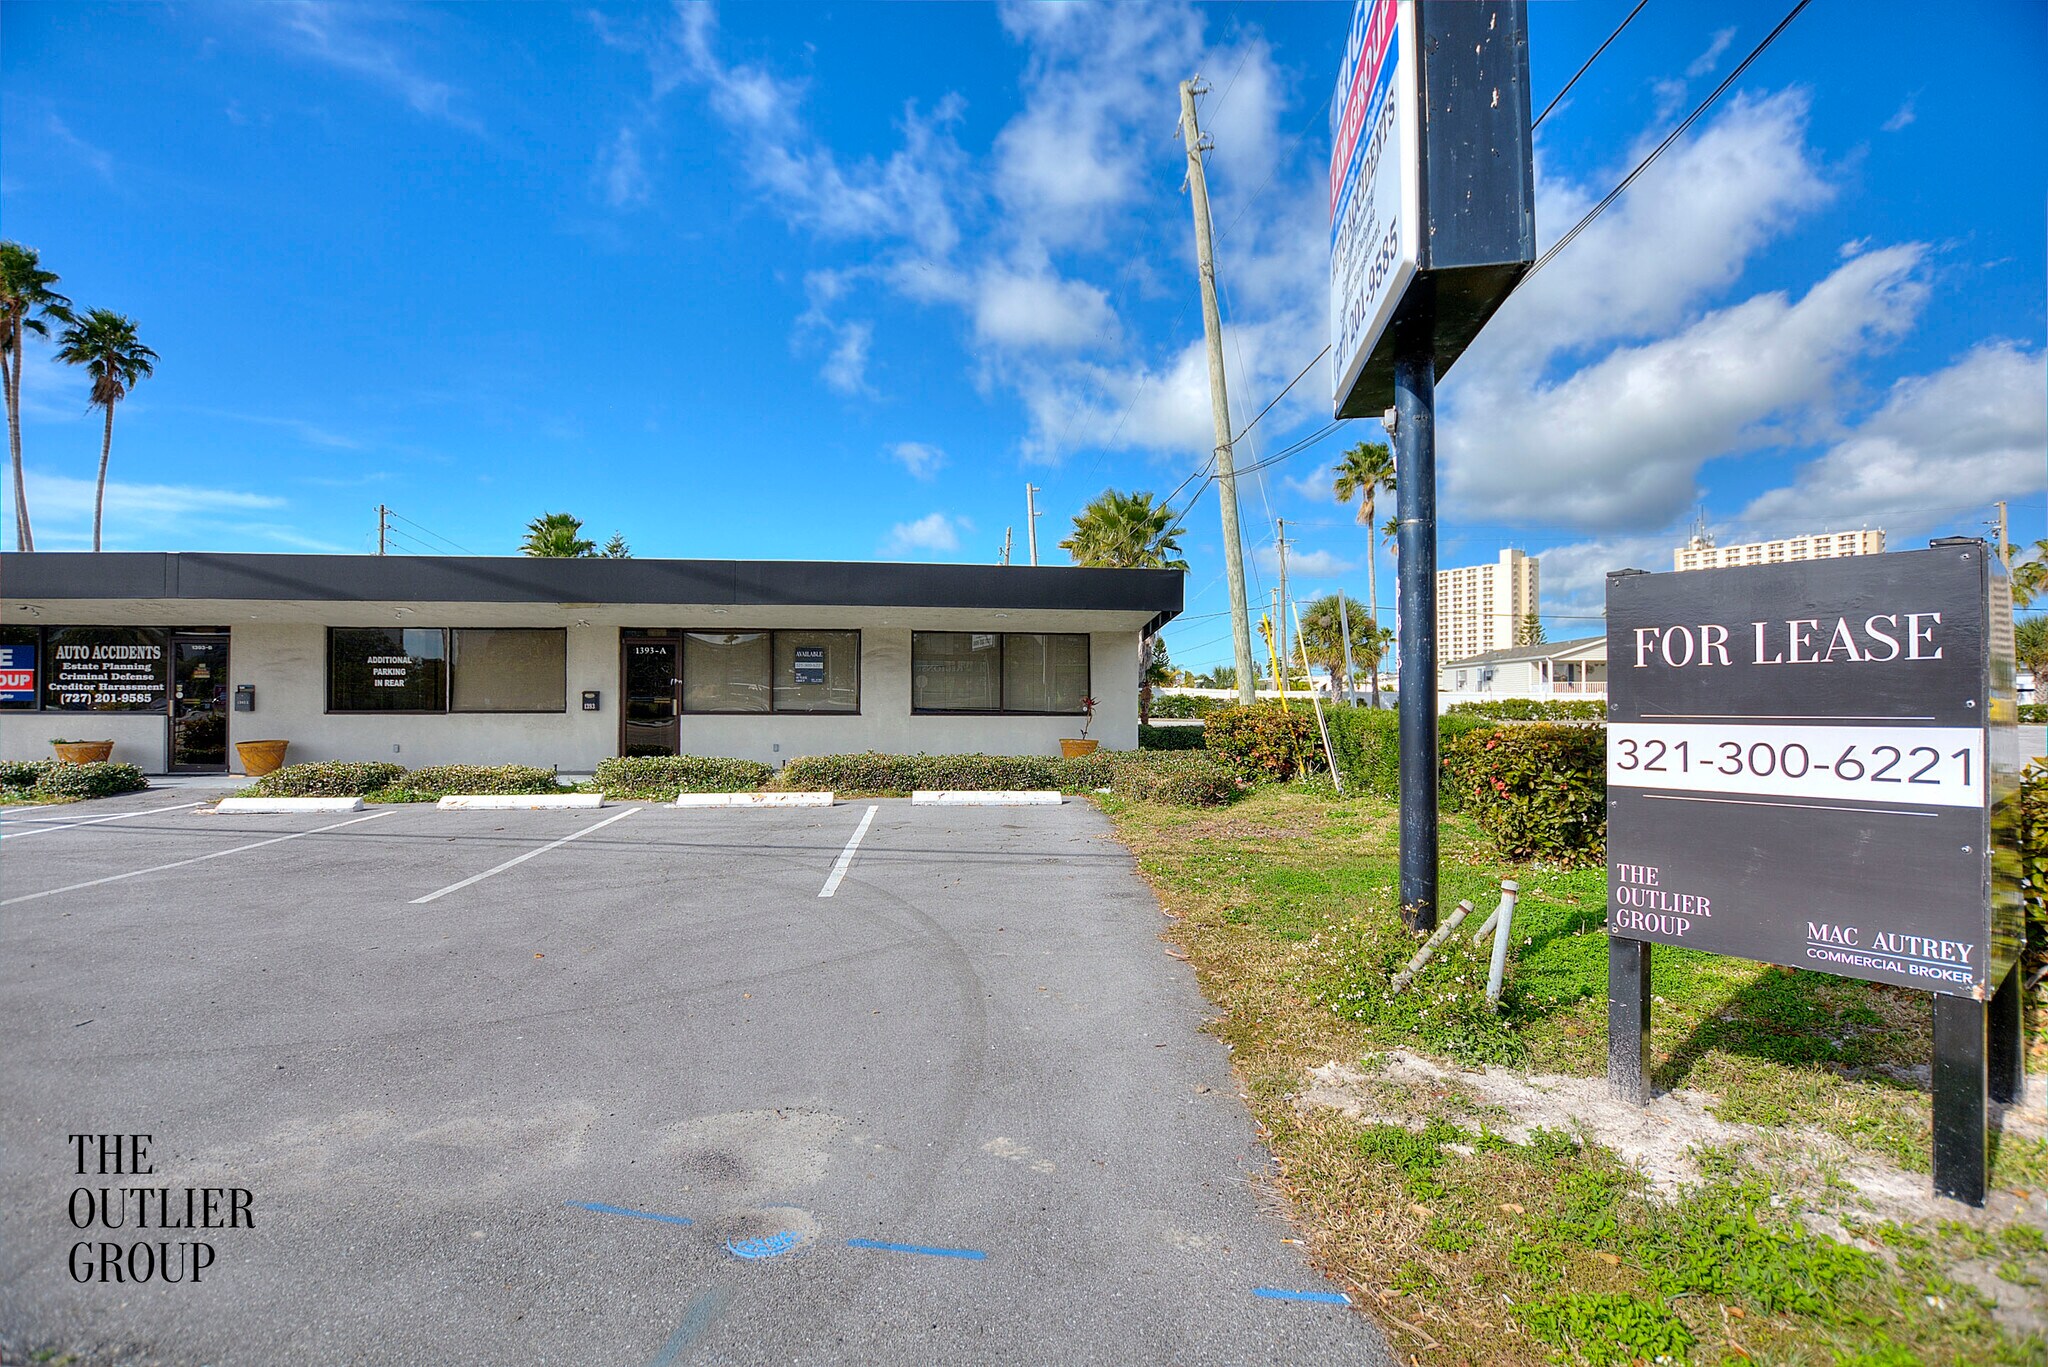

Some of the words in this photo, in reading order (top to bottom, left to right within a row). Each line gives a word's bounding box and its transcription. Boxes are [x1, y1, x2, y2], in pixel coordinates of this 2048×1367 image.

[1331, 121, 1349, 203] LAW
[1332, 224, 1347, 287] AUTO
[1347, 86, 1395, 241] ACCIDENTS
[1349, 214, 1397, 344] 201-9585
[56, 645, 89, 659] AUTO
[92, 645, 161, 659] ACCIDENTS
[1633, 624, 1732, 669] FOR
[1752, 612, 1943, 664] LEASE
[63, 663, 99, 671] Estate
[102, 663, 151, 672] Planning
[367, 657, 412, 665] ADDITIONAL
[373, 668, 406, 676] PARKING
[49, 683, 96, 691] Creditor
[99, 683, 164, 691] Harassment
[375, 679, 383, 687] IN
[385, 679, 405, 687] REAR
[61, 693, 91, 705] (727)
[95, 693, 151, 703] 201-9585
[1616, 738, 1972, 786] 321-300-6221
[1616, 863, 1660, 886] THE
[1616, 885, 1711, 917] OUTLIER
[1616, 908, 1690, 937] GROUP
[1807, 921, 1858, 947] MAC
[1871, 935, 1973, 964] AUTREY
[1806, 948, 1904, 973] COMMERCIAL
[1909, 964, 1972, 984] BROKER
